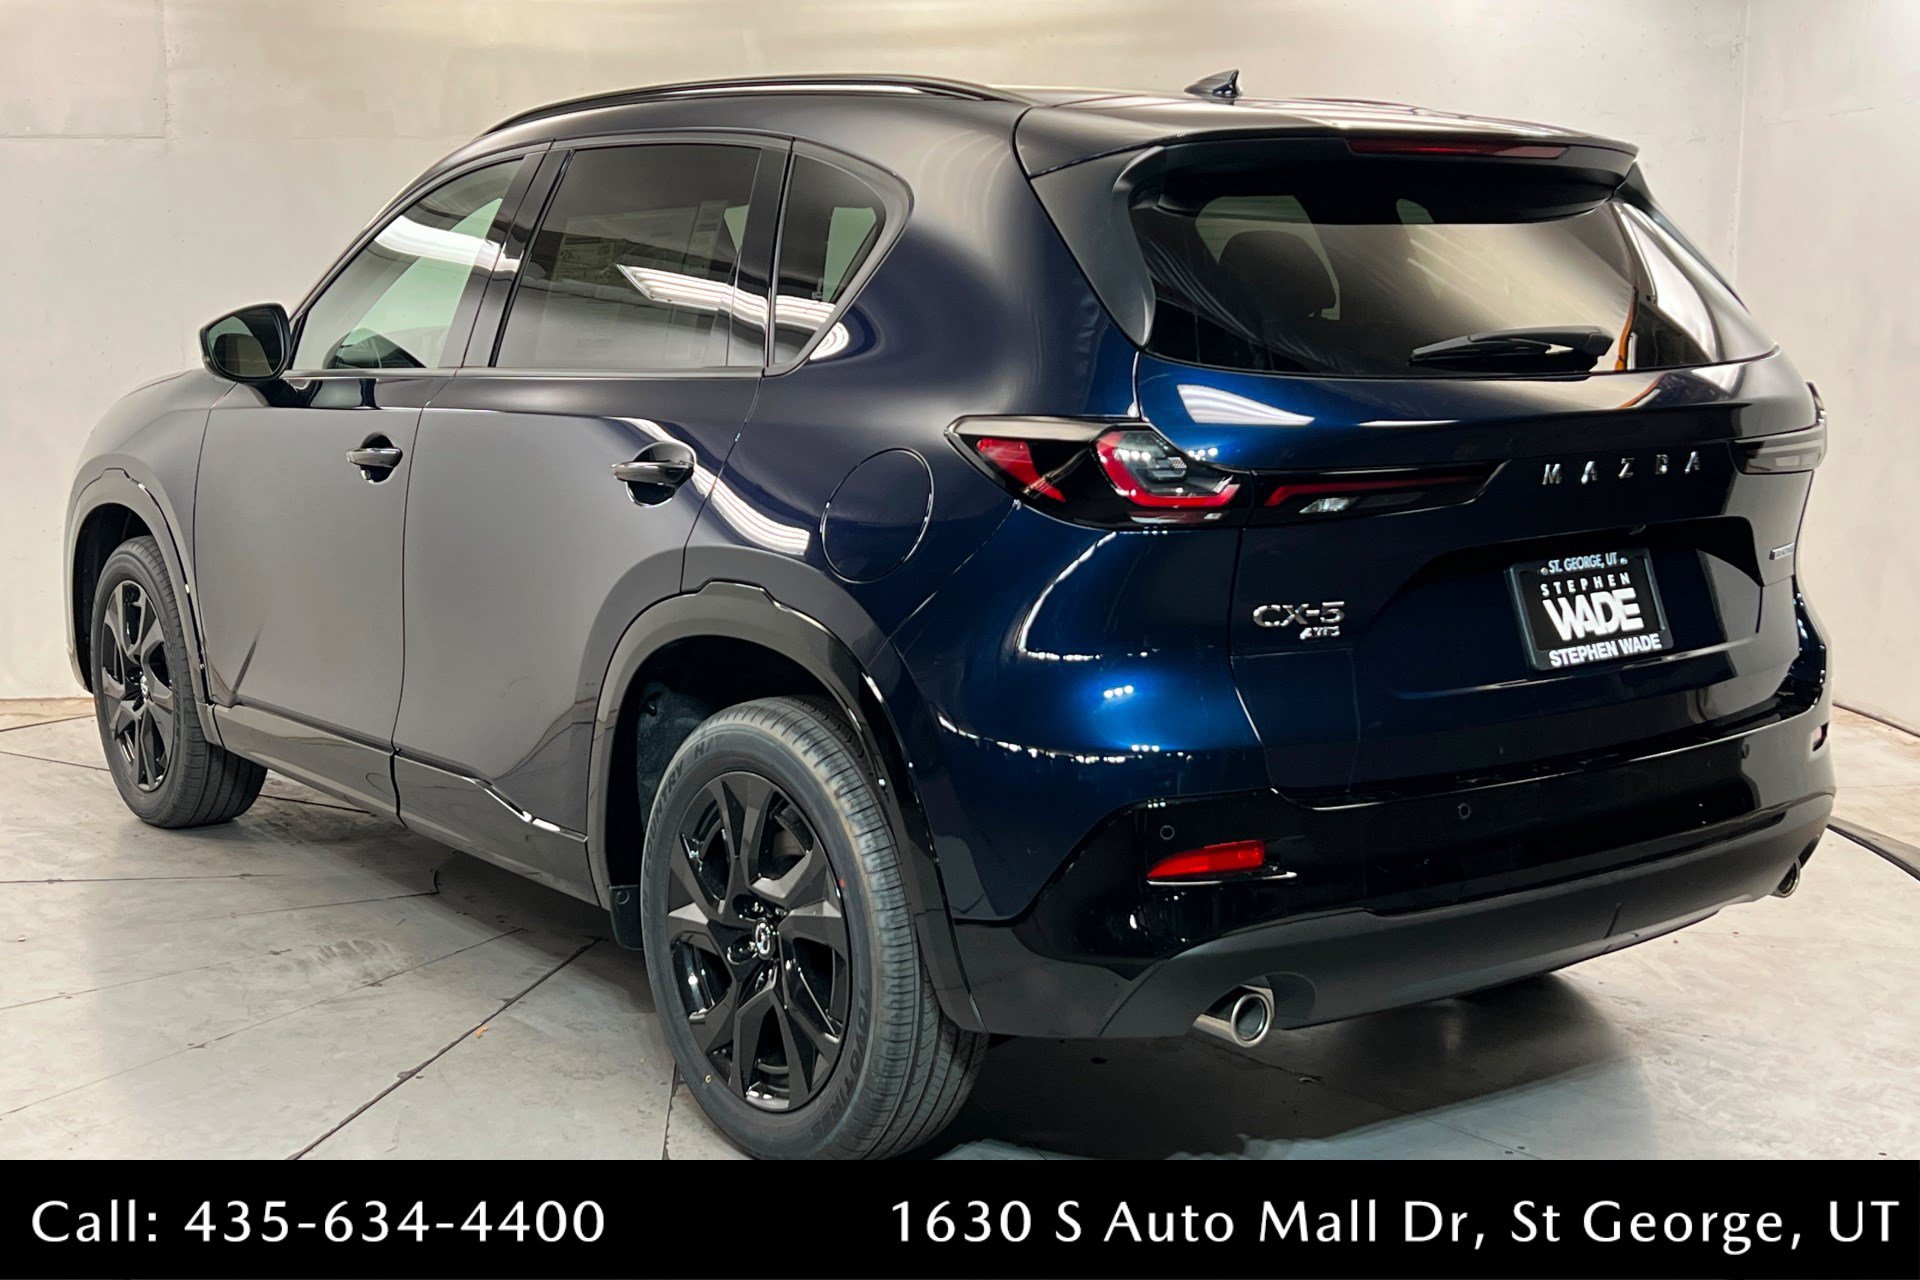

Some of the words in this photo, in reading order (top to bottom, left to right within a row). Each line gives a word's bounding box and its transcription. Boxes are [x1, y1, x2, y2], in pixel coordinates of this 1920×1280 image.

[1541, 450, 1700, 486] MAZDA
[1548, 560, 1563, 574] ST.
[1564, 554, 1604, 572] GEORGE,
[1605, 552, 1618, 565] UT
[1540, 572, 1631, 597] STEPHEN
[1253, 601, 1345, 627] CX-5
[1542, 587, 1645, 641] WADE
[1549, 639, 1618, 667] STEPHEN
[1618, 633, 1662, 656] WADE
